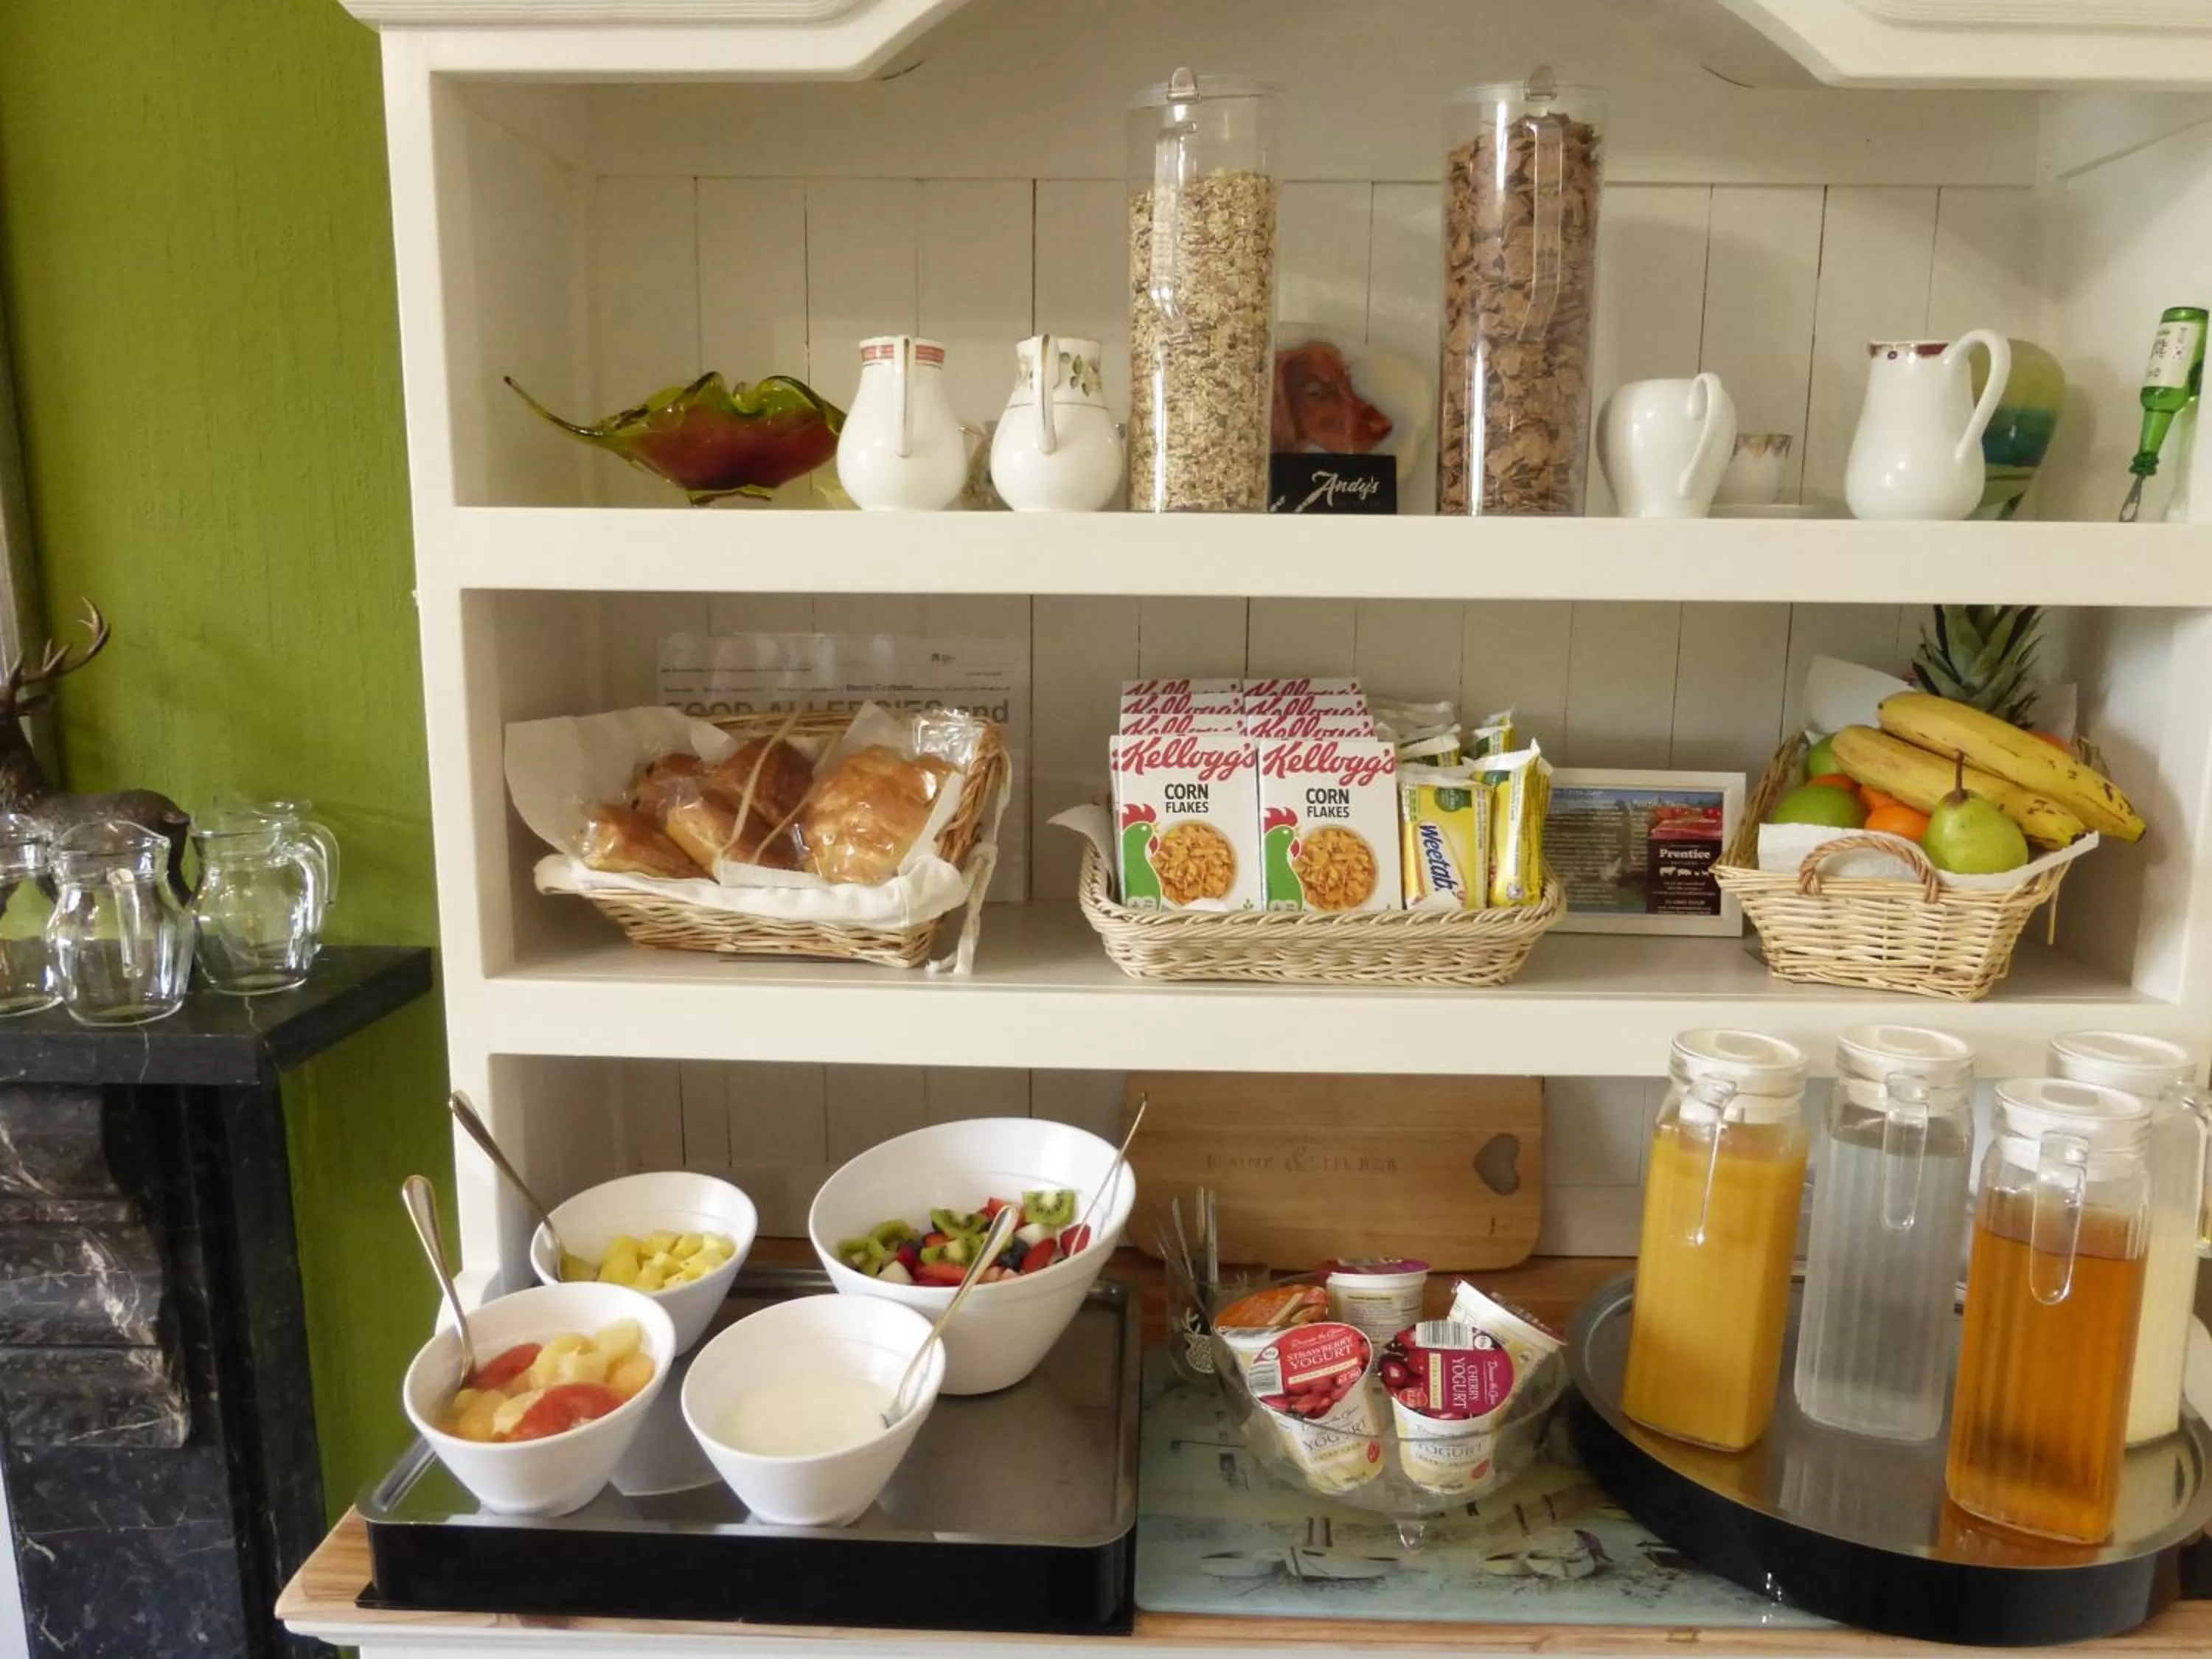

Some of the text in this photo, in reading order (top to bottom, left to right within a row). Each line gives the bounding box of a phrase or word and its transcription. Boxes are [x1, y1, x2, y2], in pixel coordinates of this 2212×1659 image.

[1295, 470, 1380, 512] Andy's
[1121, 737, 1256, 781] Kellogg's
[1262, 742, 1395, 787] Kellogg's
[1164, 784, 1209, 800] CORN
[1306, 788, 1350, 804] CORN
[1165, 801, 1209, 813] FLAKES
[1307, 806, 1351, 818] FLAKES
[1659, 849, 1711, 859] Prentice
[1287, 1334, 1352, 1361] STRAWBERRY
[1290, 1343, 1352, 1369] YOGURT
[1452, 1357, 1467, 1409] YOGURT
[1467, 1364, 1479, 1401] CHERRY
